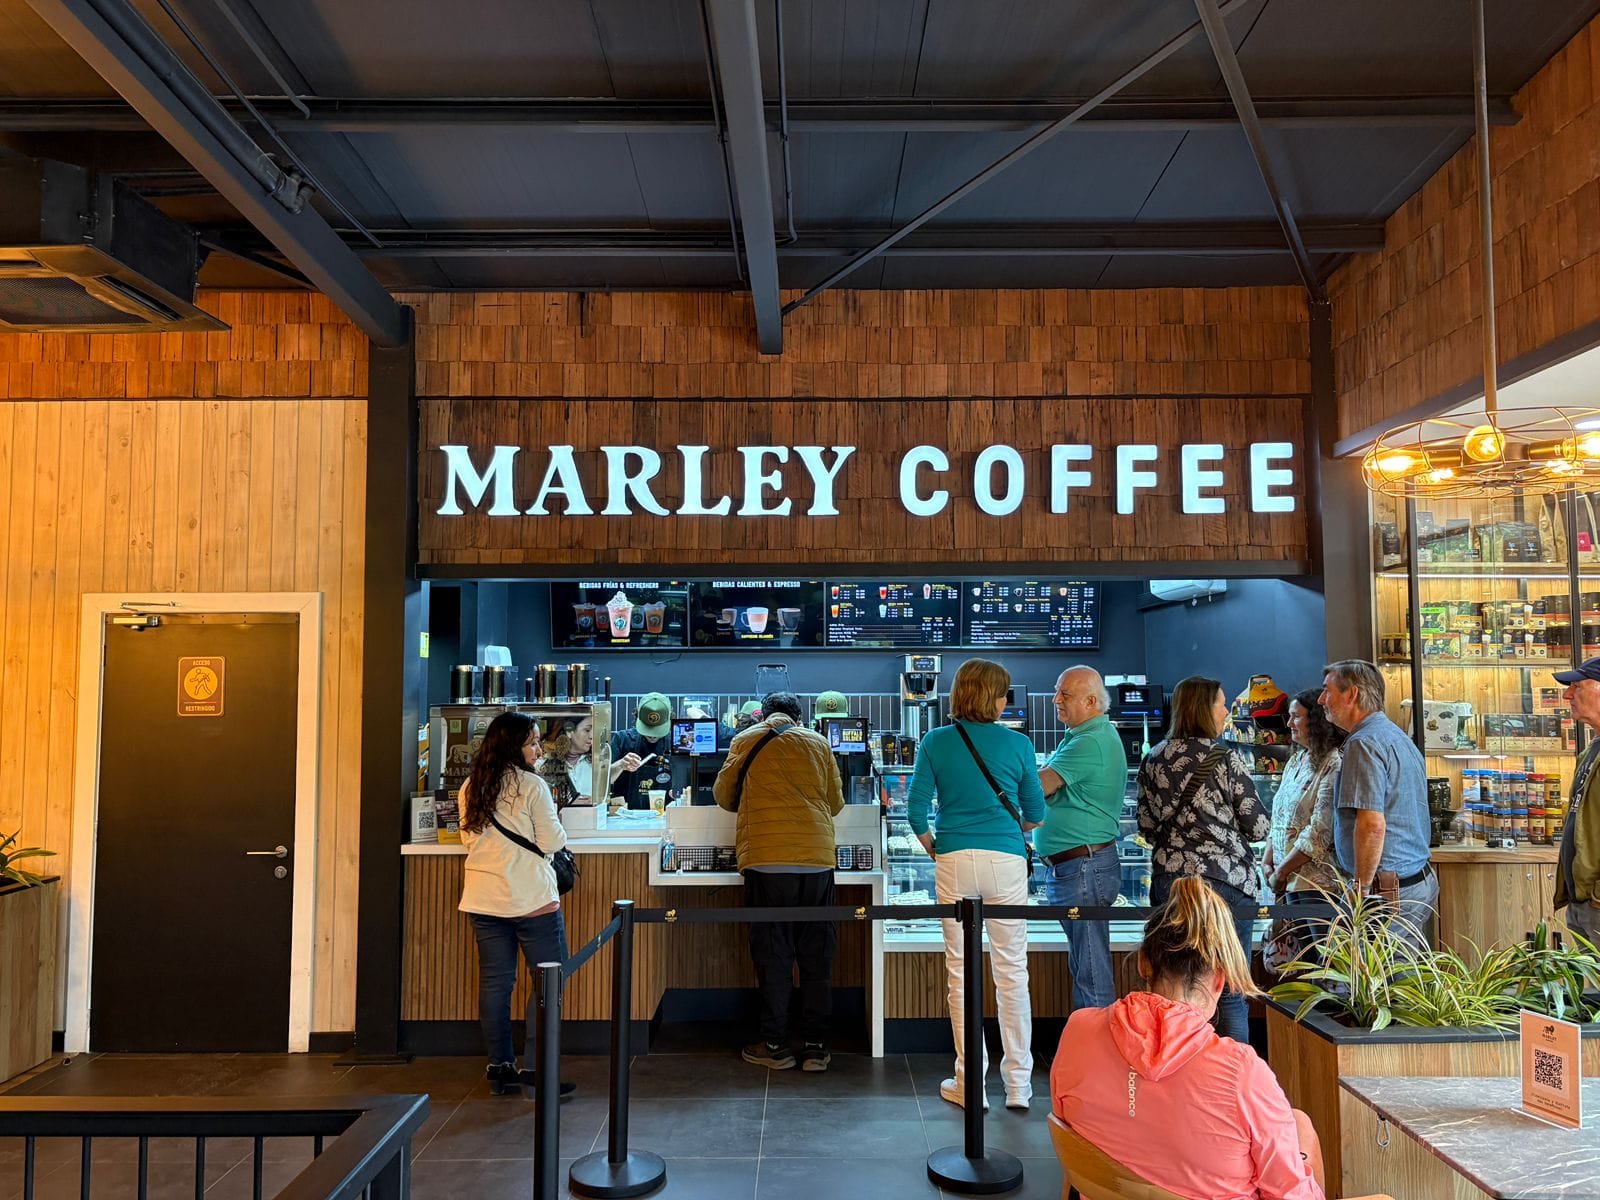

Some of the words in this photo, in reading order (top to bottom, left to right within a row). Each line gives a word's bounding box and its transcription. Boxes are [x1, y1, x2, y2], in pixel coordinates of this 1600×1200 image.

[436, 444, 857, 517] MARLEY
[899, 442, 1296, 517] COFFEE
[1128, 1072, 1137, 1117] balance
